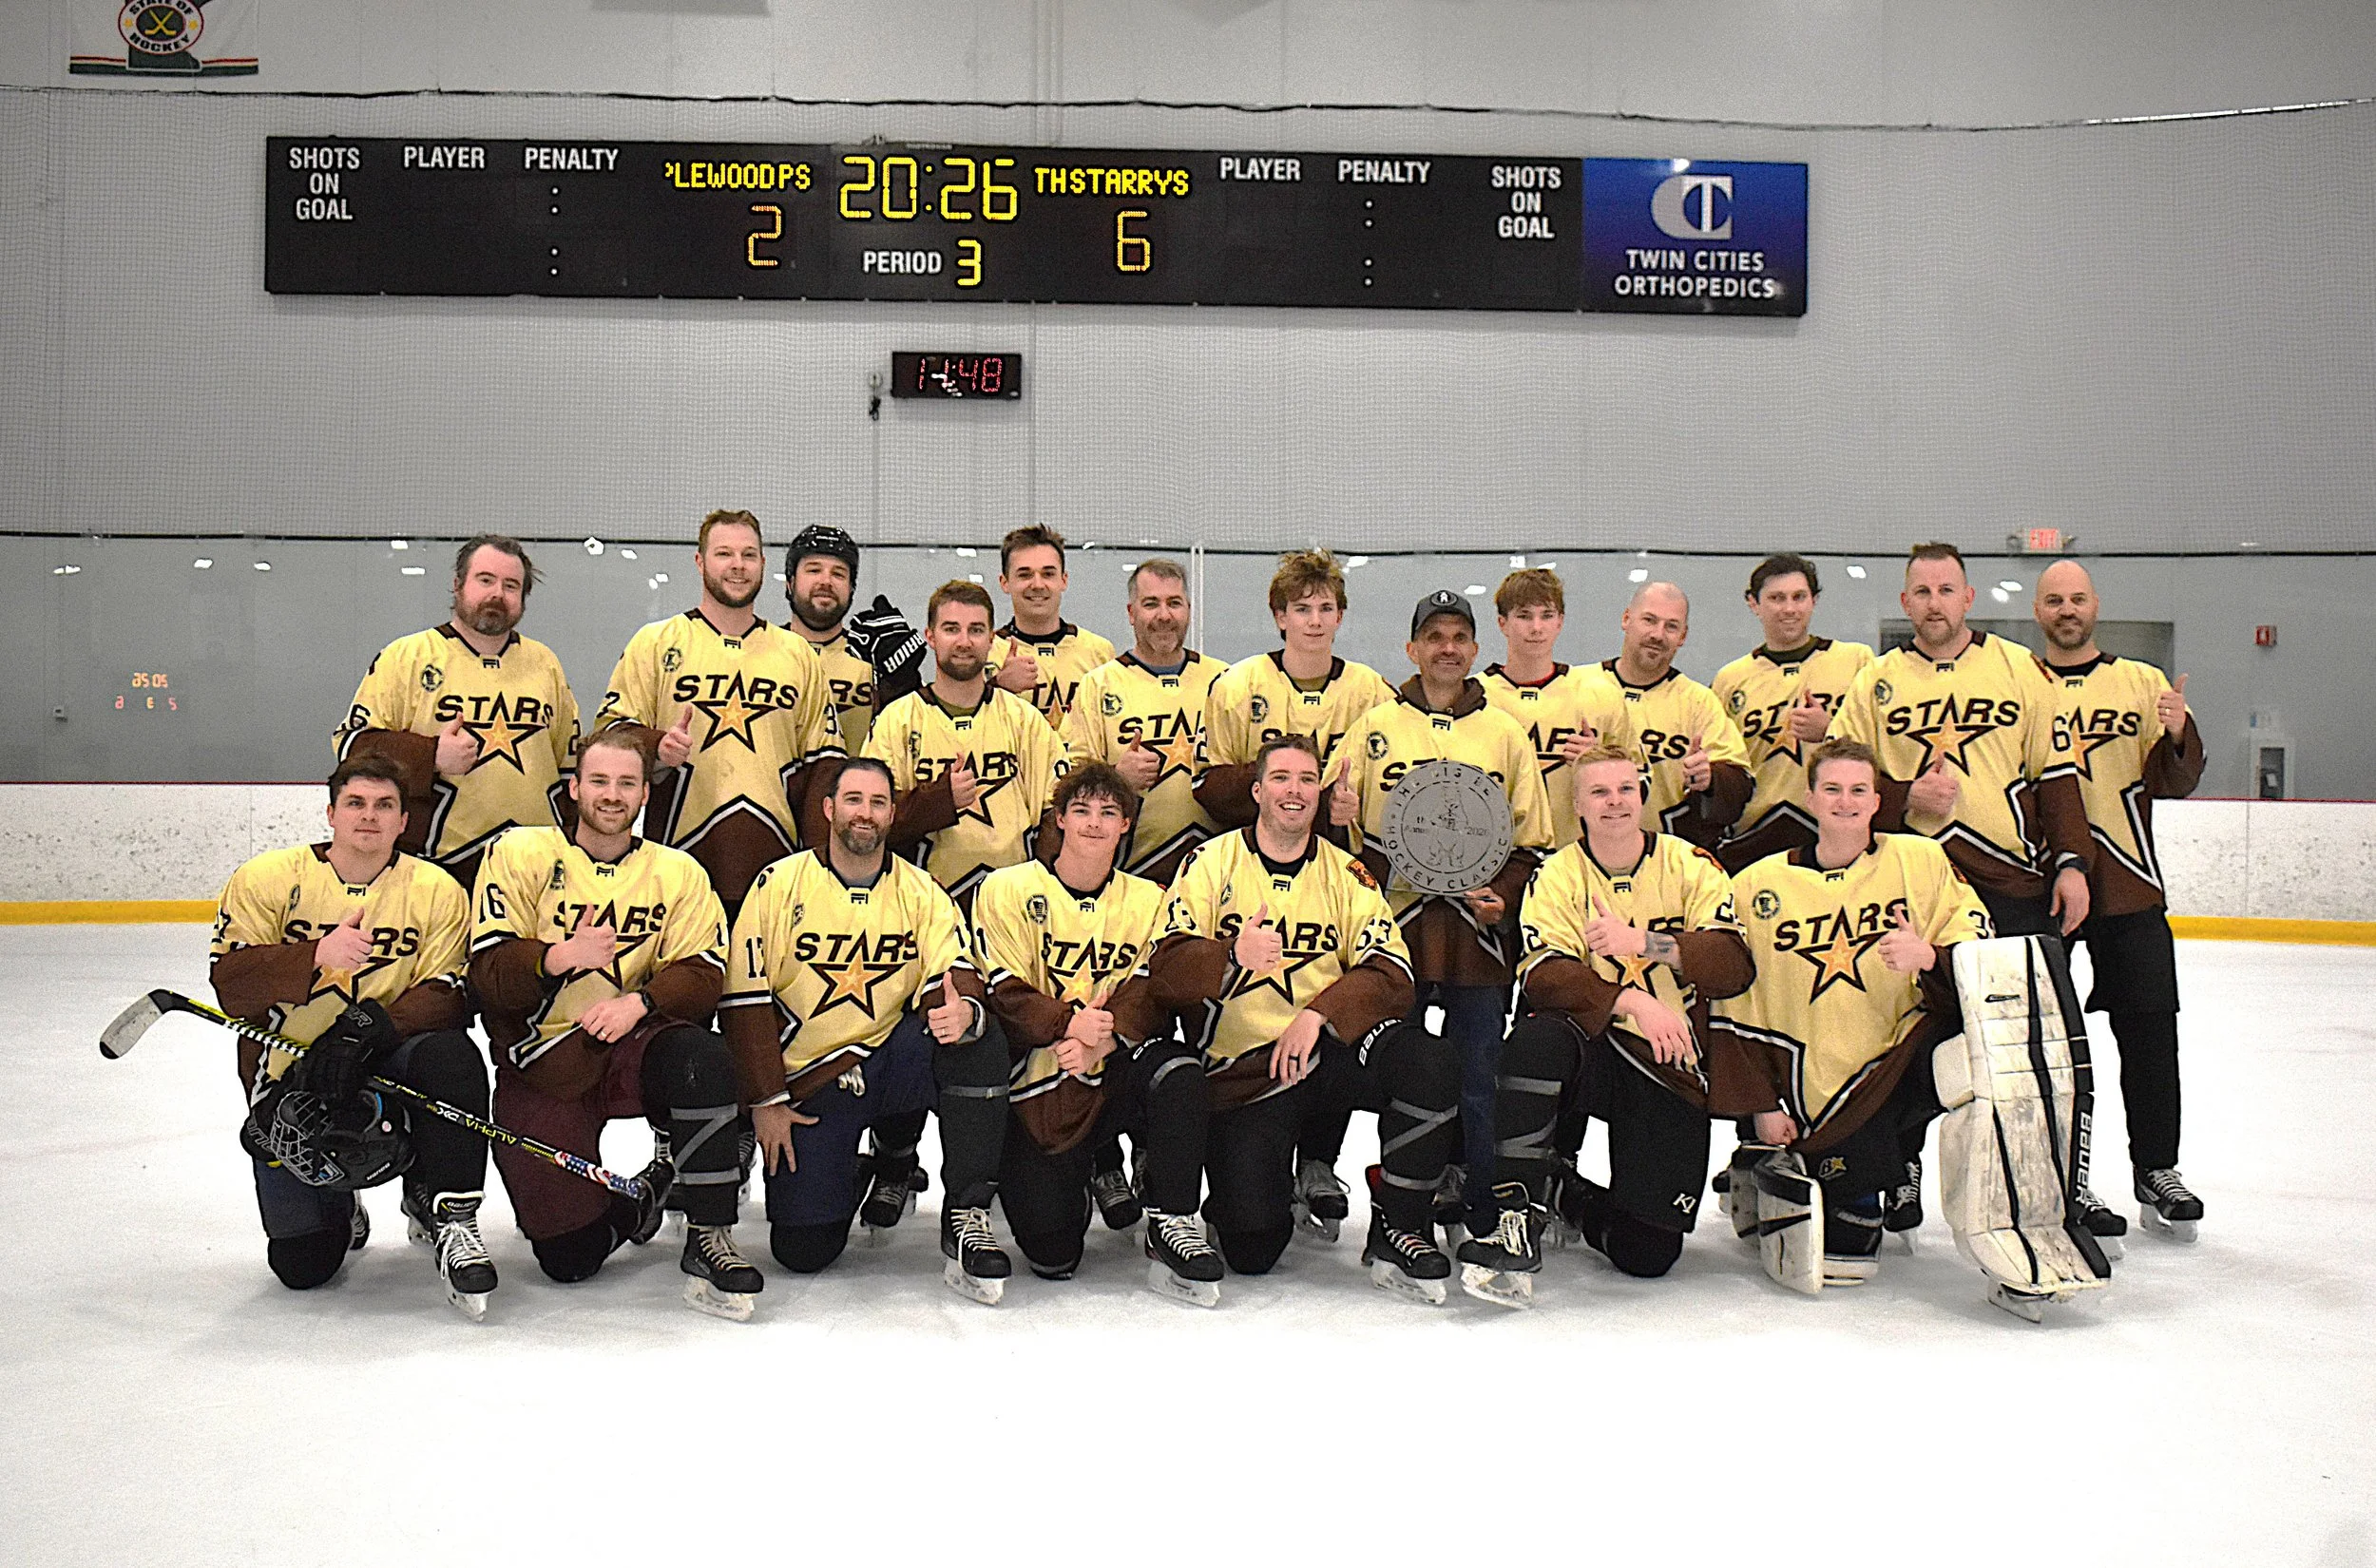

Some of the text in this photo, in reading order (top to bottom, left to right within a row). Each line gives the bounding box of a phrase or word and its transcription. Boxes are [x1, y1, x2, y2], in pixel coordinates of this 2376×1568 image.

[129, 32, 190, 52] HOCKEY
[289, 147, 360, 169] SHOTS
[404, 146, 486, 169] PLAYER
[525, 147, 619, 170] PENALTY
[1220, 157, 1301, 181] PLAYER
[309, 173, 339, 195] ON
[1338, 160, 1430, 183] PENALTY
[1491, 165, 1562, 189] SHOTS
[839, 156, 1018, 220] 20:26
[296, 198, 354, 220] GOAL
[1510, 191, 1542, 213] ON
[747, 205, 782, 266] 2
[1498, 216, 1555, 239] GOAL
[1117, 210, 1151, 272] 6
[863, 250, 942, 274] PERIOD
[957, 239, 982, 286] 3
[1625, 249, 1765, 272] TWIN CITIES
[1615, 276, 1781, 298] ORTHOPEDICS
[883, 632, 926, 674] RRIOR
[672, 669, 799, 711] STARS
[434, 691, 554, 730] STARS
[1886, 693, 2021, 736] STARS
[552, 898, 667, 935] STARS
[1772, 896, 1911, 953] STARS
[794, 927, 918, 964] STARS
[1041, 931, 1139, 971] STARS
[464, 1117, 518, 1145] ALPHA
[2075, 1111, 2093, 1204] BAUER
